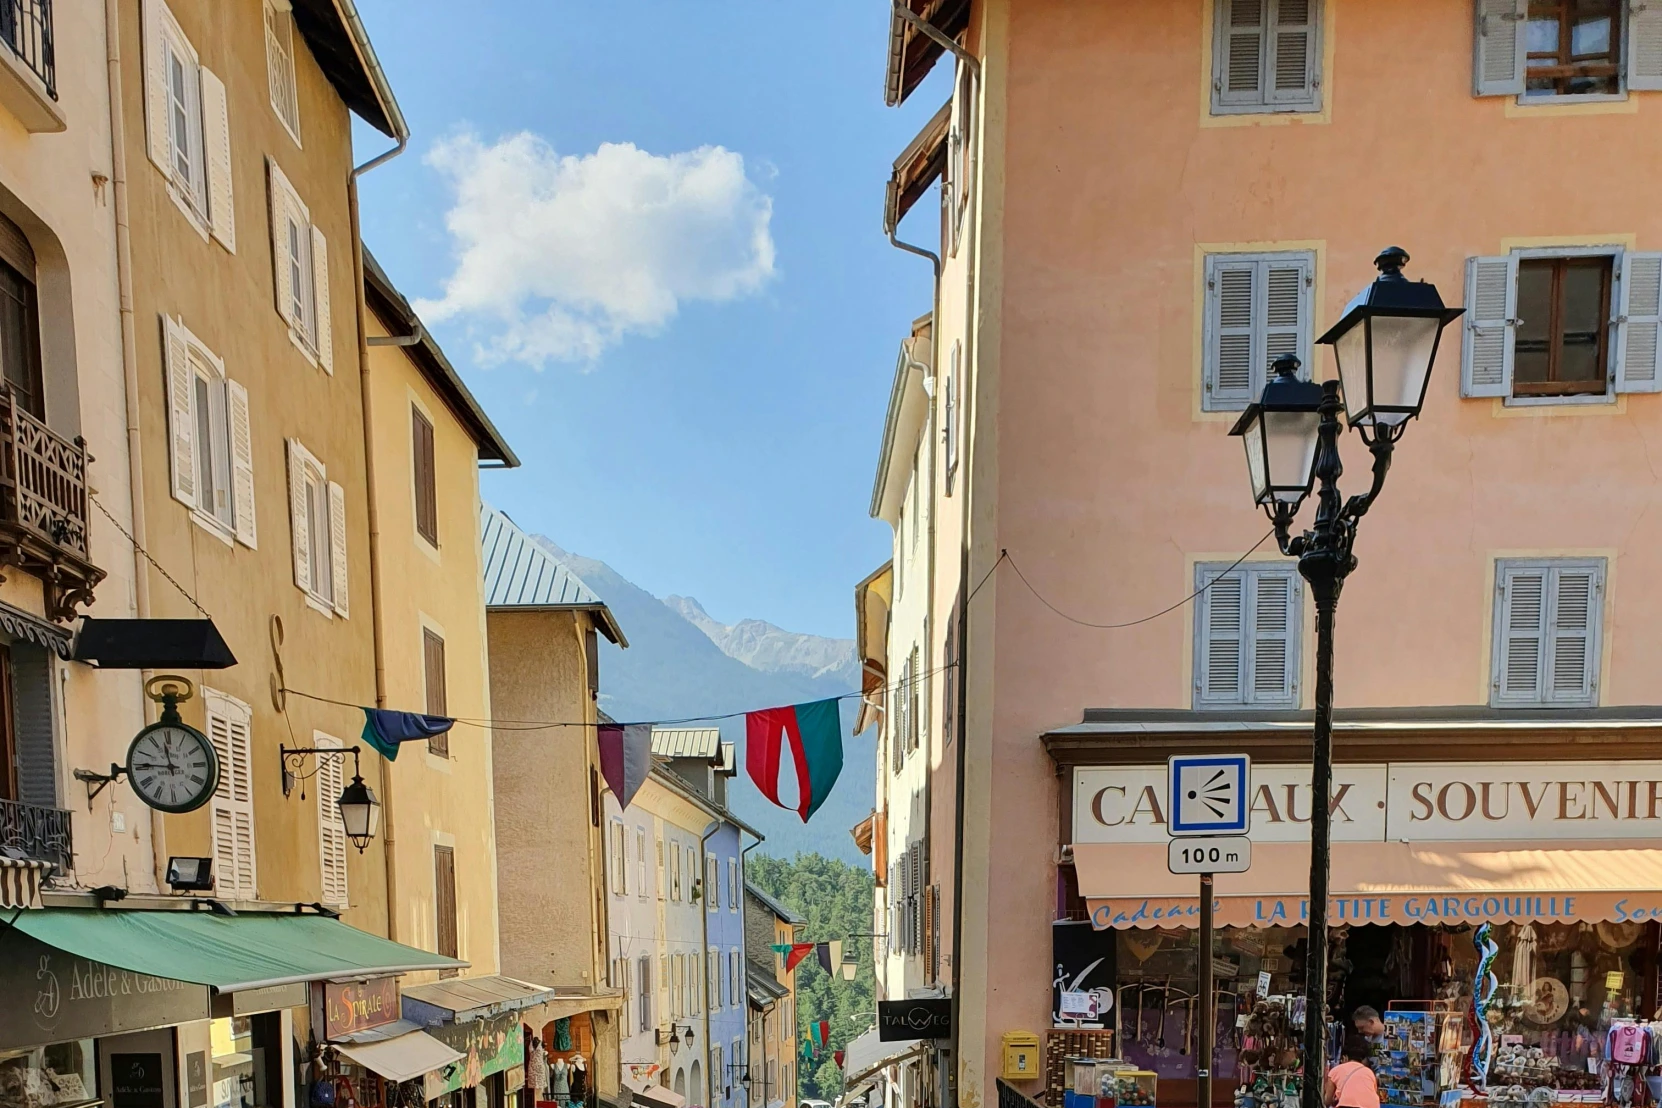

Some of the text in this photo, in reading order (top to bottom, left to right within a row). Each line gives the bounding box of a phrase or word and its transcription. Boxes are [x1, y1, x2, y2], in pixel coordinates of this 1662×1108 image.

[1091, 783, 1355, 827] CAAUX
[1182, 847, 1239, 864] 100 m
[1256, 900, 1287, 923] LA
[1404, 897, 1576, 921] GARGOUILLE
